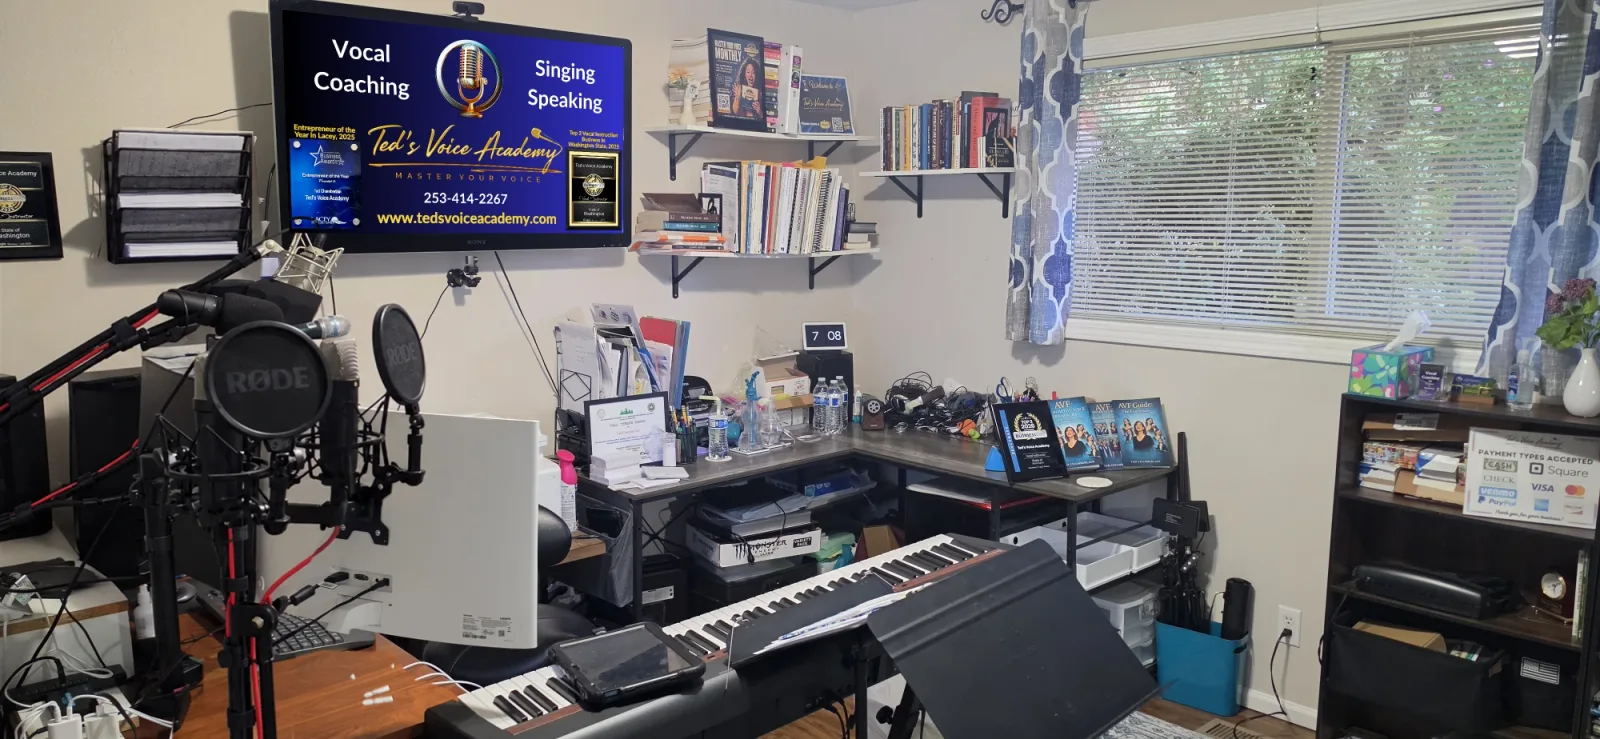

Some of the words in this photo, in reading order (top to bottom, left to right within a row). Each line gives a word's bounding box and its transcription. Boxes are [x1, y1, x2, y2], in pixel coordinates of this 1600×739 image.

[332, 38, 390, 63] Vocal
[714, 46, 742, 62] MONTHLY
[535, 59, 596, 85] Singing
[314, 72, 410, 100] Coaching
[528, 88, 603, 114] Speaking
[293, 123, 336, 133] Entrepreneur
[318, 132, 338, 140] Lacey,
[368, 124, 420, 156] Ted's
[425, 124, 473, 158] Voice
[474, 129, 563, 174] Academy
[395, 172, 452, 181] MASTER
[501, 175, 541, 183] VOICE
[424, 192, 508, 204] 253-414-2267
[377, 212, 557, 227] www.tedsvoiceacademy.com
[812, 332, 819, 341] 7
[827, 331, 841, 341] 08
[226, 366, 310, 394] RØDE
[1478, 449, 1517, 458] PAYMENT
[1519, 452, 1545, 460] TYPES
[1547, 455, 1594, 465] ACCEPTED
[1548, 465, 1589, 478] Square
[1483, 474, 1515, 484] CHECK
[1481, 487, 1515, 497] venmo
[1531, 483, 1555, 492] VISA
[1489, 498, 1516, 507] PayPal
